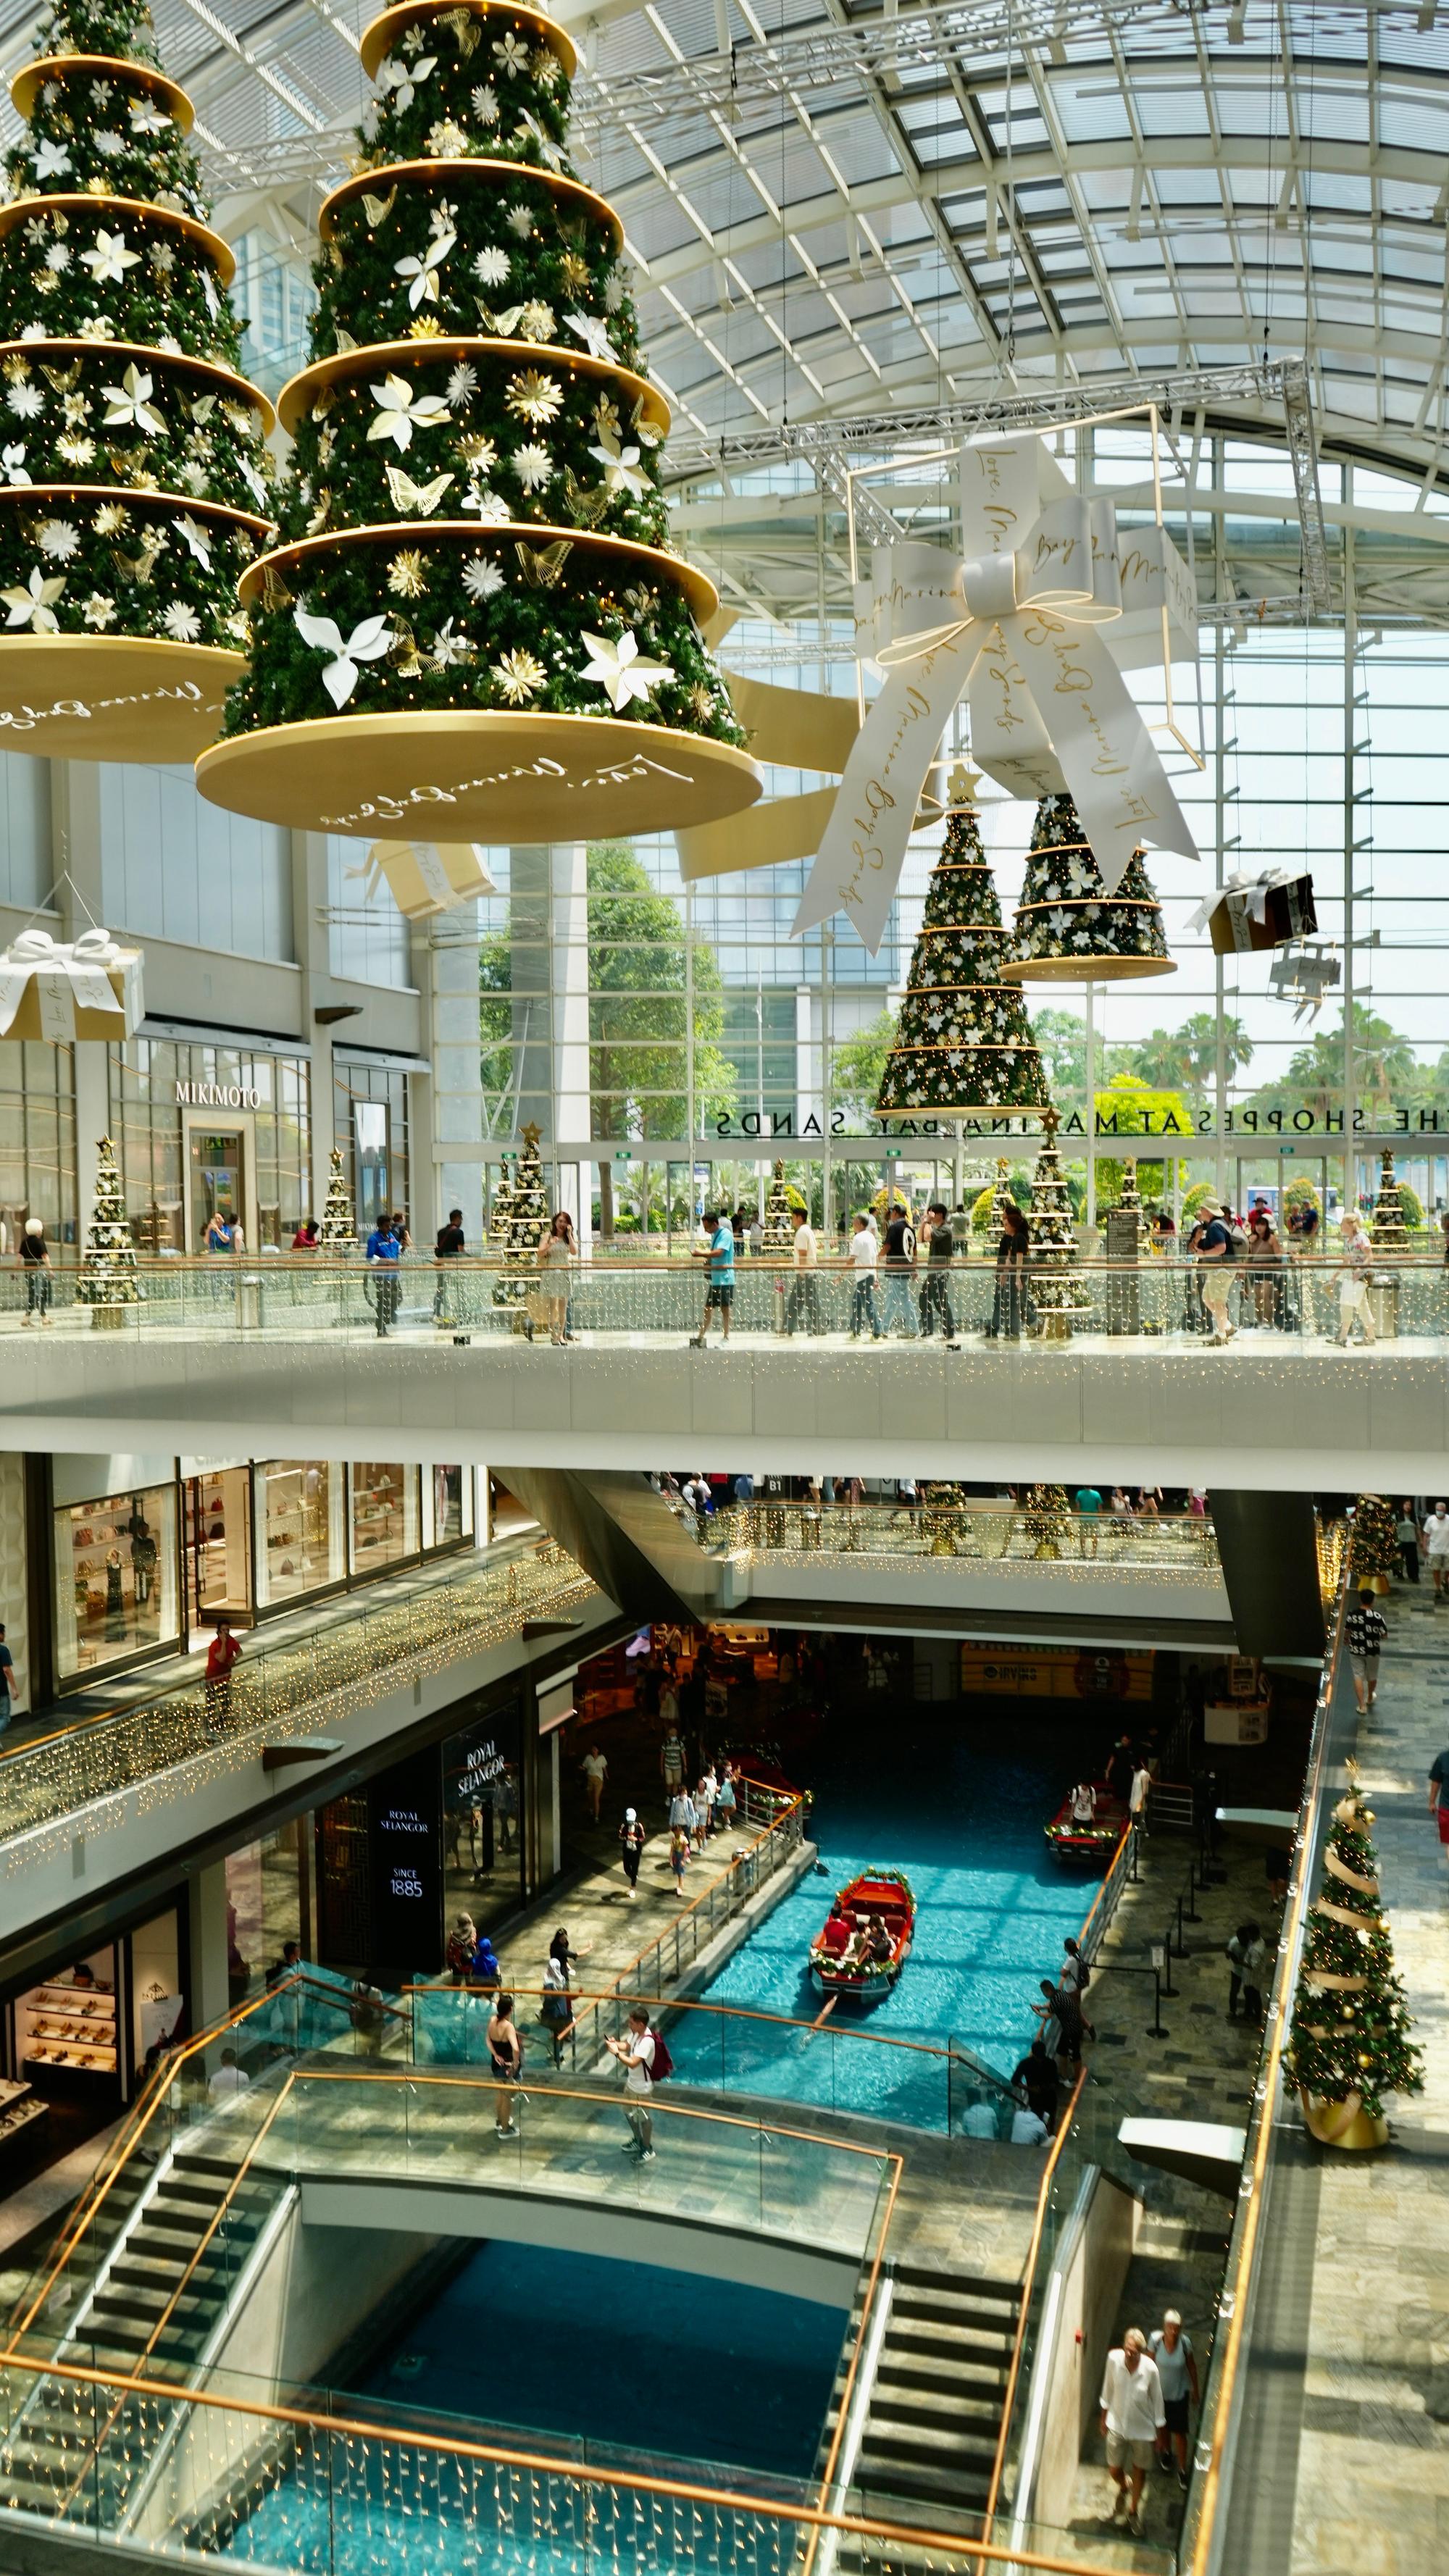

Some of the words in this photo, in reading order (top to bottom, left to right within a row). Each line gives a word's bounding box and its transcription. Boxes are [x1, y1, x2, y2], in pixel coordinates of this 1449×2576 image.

[1032, 533, 1082, 574] Bay
[1053, 642, 1093, 693] Bay
[989, 663, 1026, 735] Sands
[882, 686, 930, 783] Marina
[1078, 695, 1129, 777] Marina
[854, 779, 896, 840] Bay
[838, 840, 883, 908] Sands
[175, 1080, 262, 1110] MIKIMOTO
[769, 1480, 781, 1492] B1
[467, 1739, 497, 1771] ROYAL
[457, 1754, 506, 1798] SELANGOR
[380, 1820, 429, 1833] SELANGOR
[389, 1810, 420, 1822] ROYAL
[390, 1878, 423, 1898] 1885
[393, 1868, 417, 1879] SINCE
